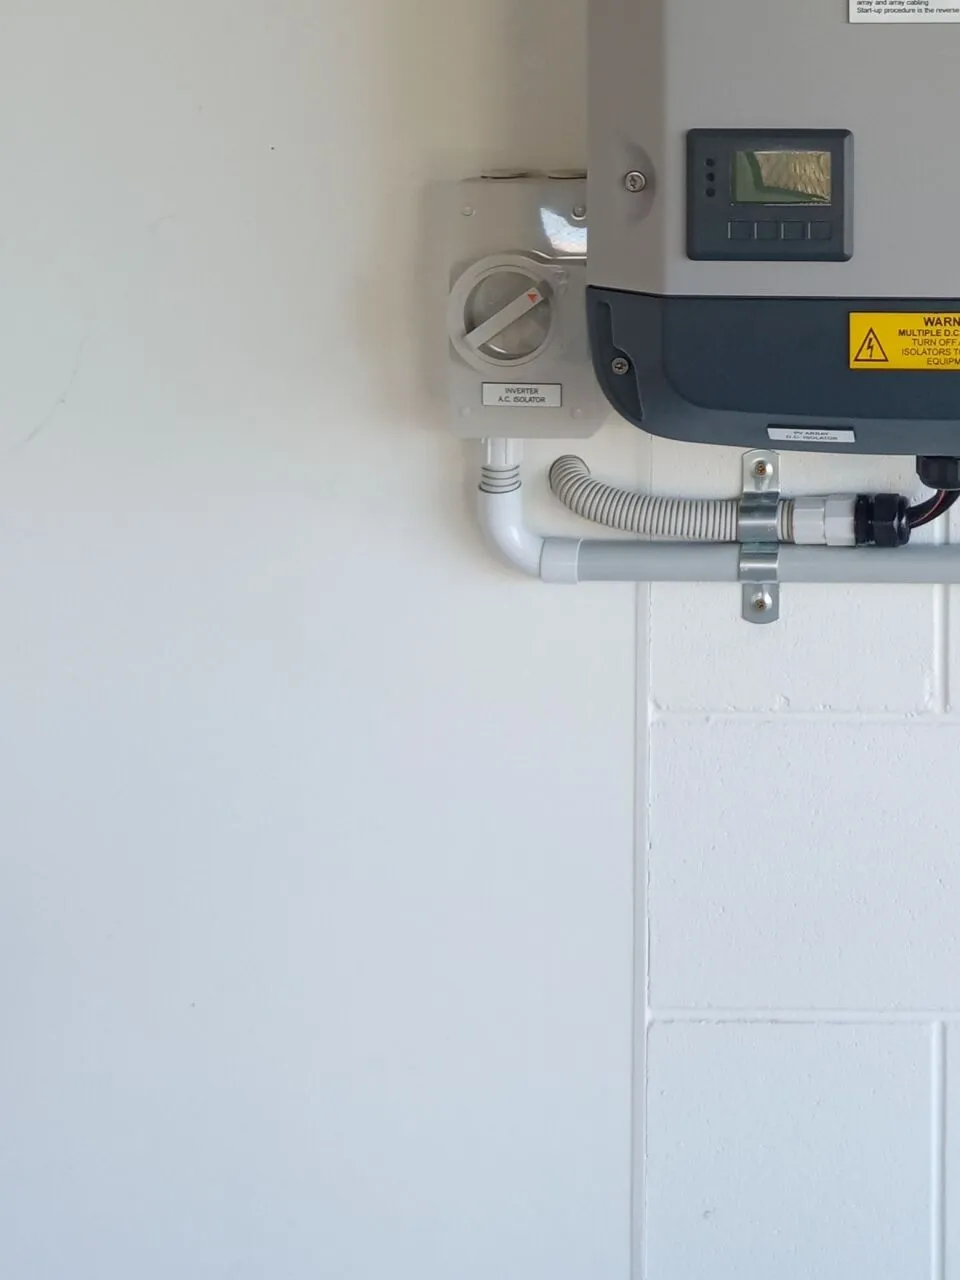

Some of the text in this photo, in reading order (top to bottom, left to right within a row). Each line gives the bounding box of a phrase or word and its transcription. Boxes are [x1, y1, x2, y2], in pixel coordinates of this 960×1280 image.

[898, 329, 942, 337] MULTIPLE
[912, 338, 937, 346] TURN
[938, 338, 956, 346] OFF
[902, 348, 951, 356] ISOLATORS
[505, 387, 539, 395] INVERTER
